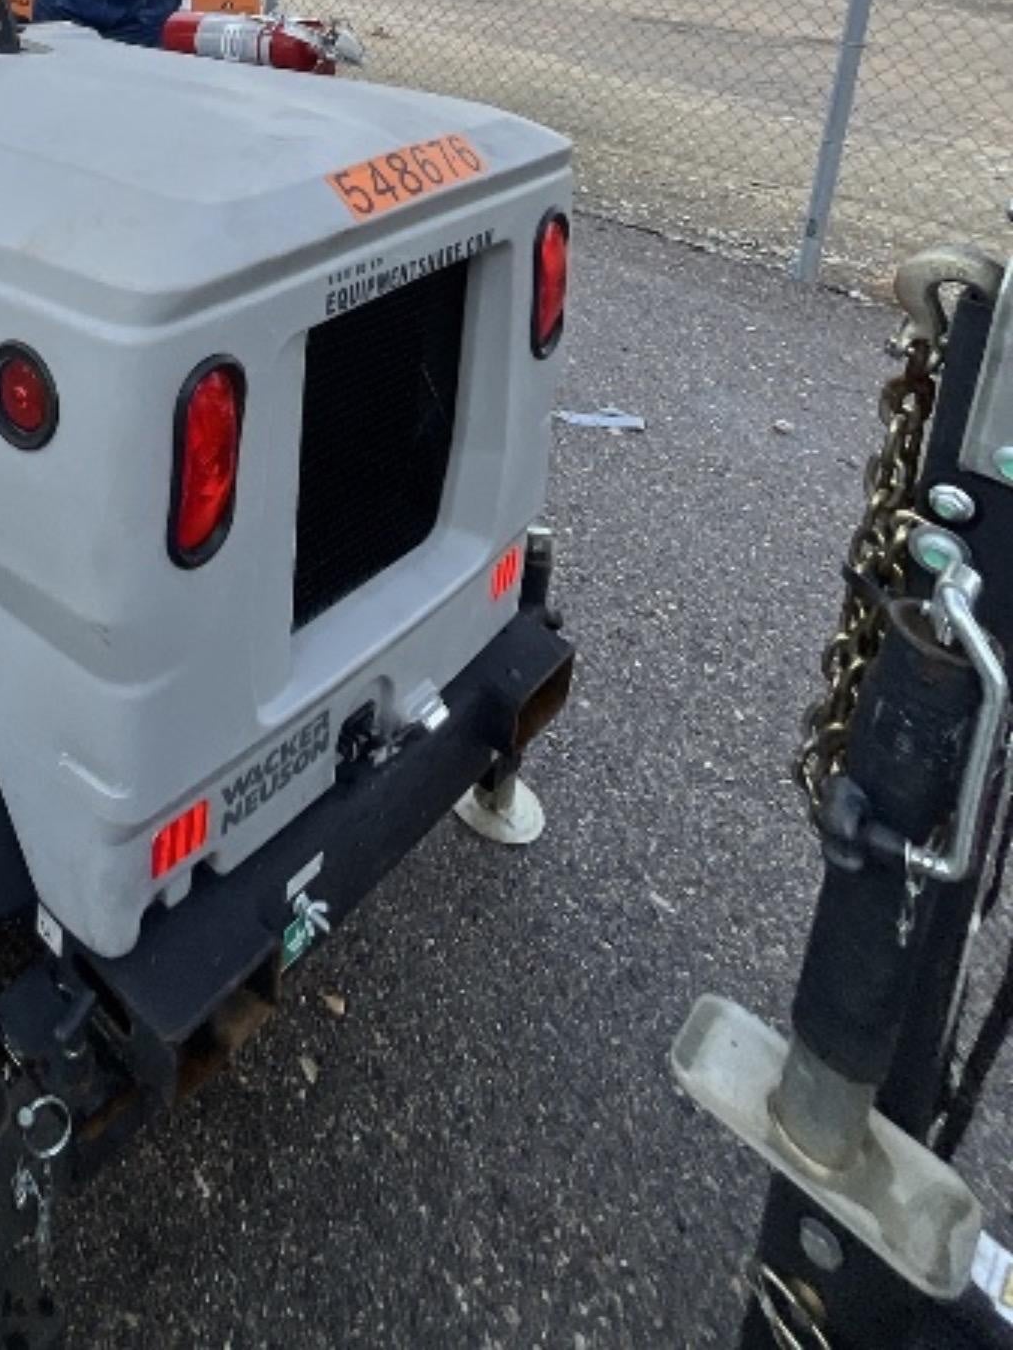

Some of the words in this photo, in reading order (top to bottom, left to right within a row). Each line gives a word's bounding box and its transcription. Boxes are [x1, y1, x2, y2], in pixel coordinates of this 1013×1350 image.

[334, 135, 480, 213] 548676
[220, 709, 330, 806] WACKER
[220, 732, 330, 836] NEUSON
